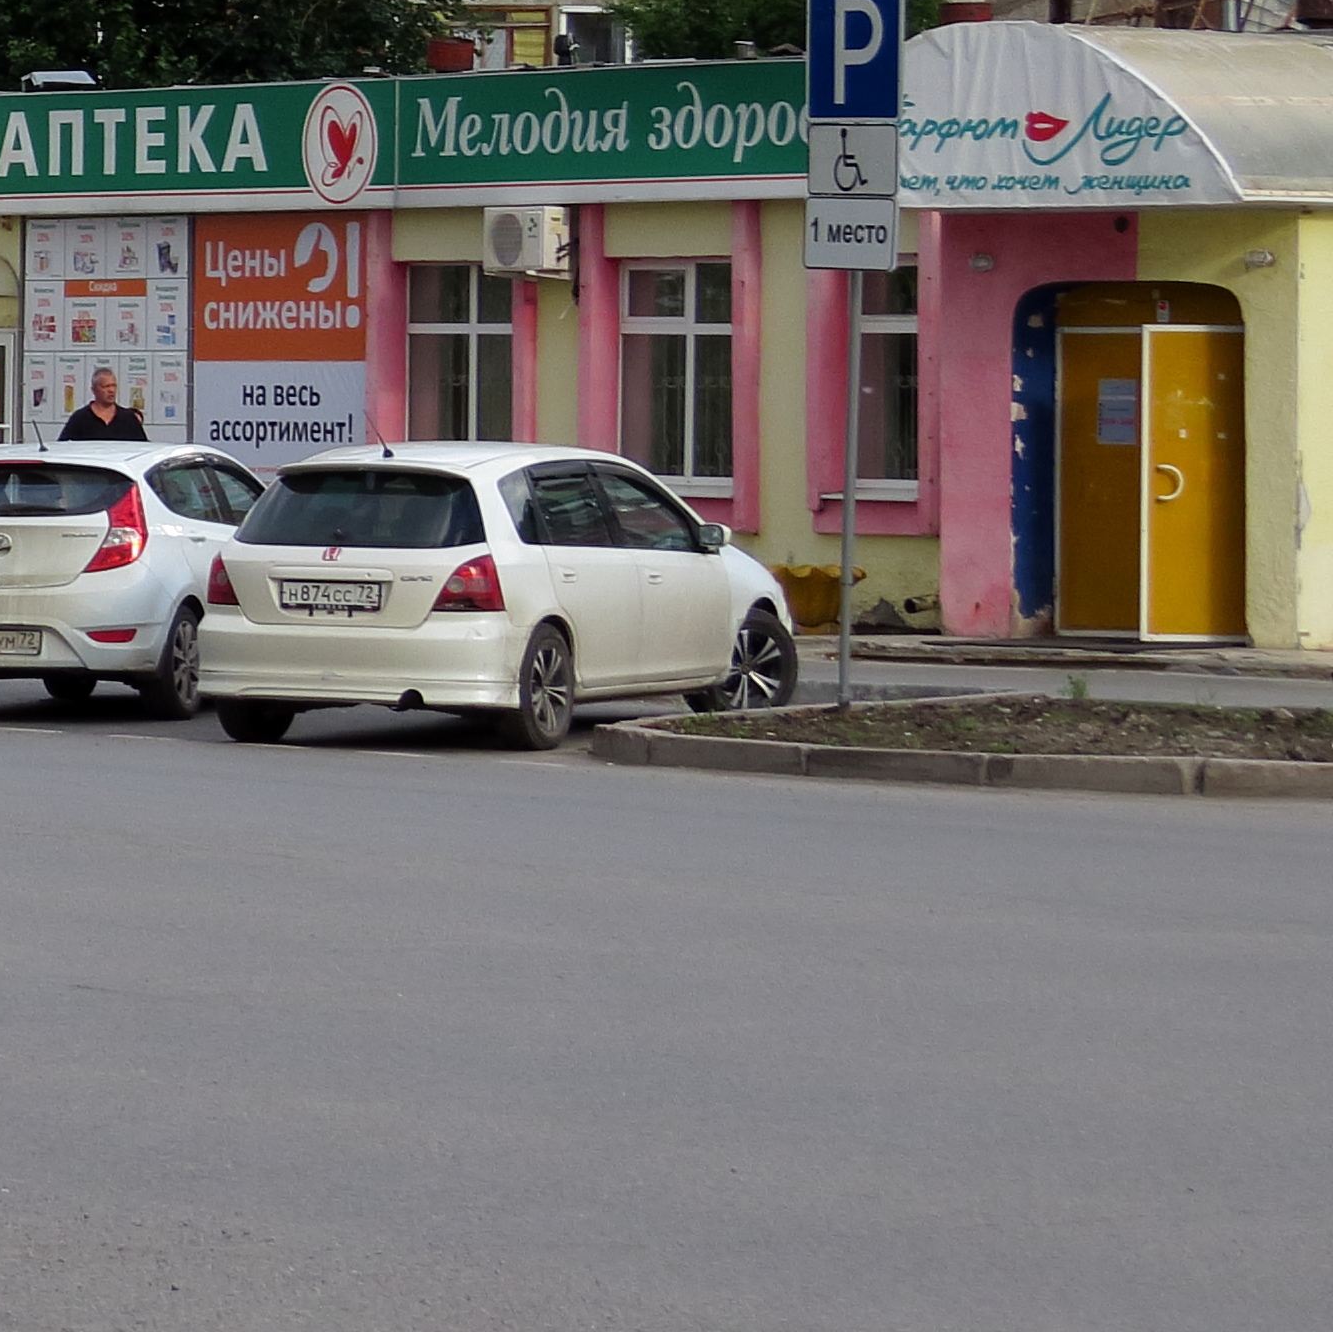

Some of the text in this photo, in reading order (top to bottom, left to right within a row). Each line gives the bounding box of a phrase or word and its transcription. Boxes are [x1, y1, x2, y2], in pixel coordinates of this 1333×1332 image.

[411, 87, 630, 158] Мелодия
[899, 92, 1188, 166] арфюм Лидер
[945, 174, 987, 191] что
[991, 174, 1060, 191] хочет
[1063, 175, 1191, 195] женщина
[810, 217, 888, 244] 1 место
[205, 241, 286, 287] Цены
[242, 384, 321, 406] на весь
[209, 413, 353, 449] ассортимент!
[288, 584, 374, 603] Н874СС 72
[20, 631, 35, 646] 72
